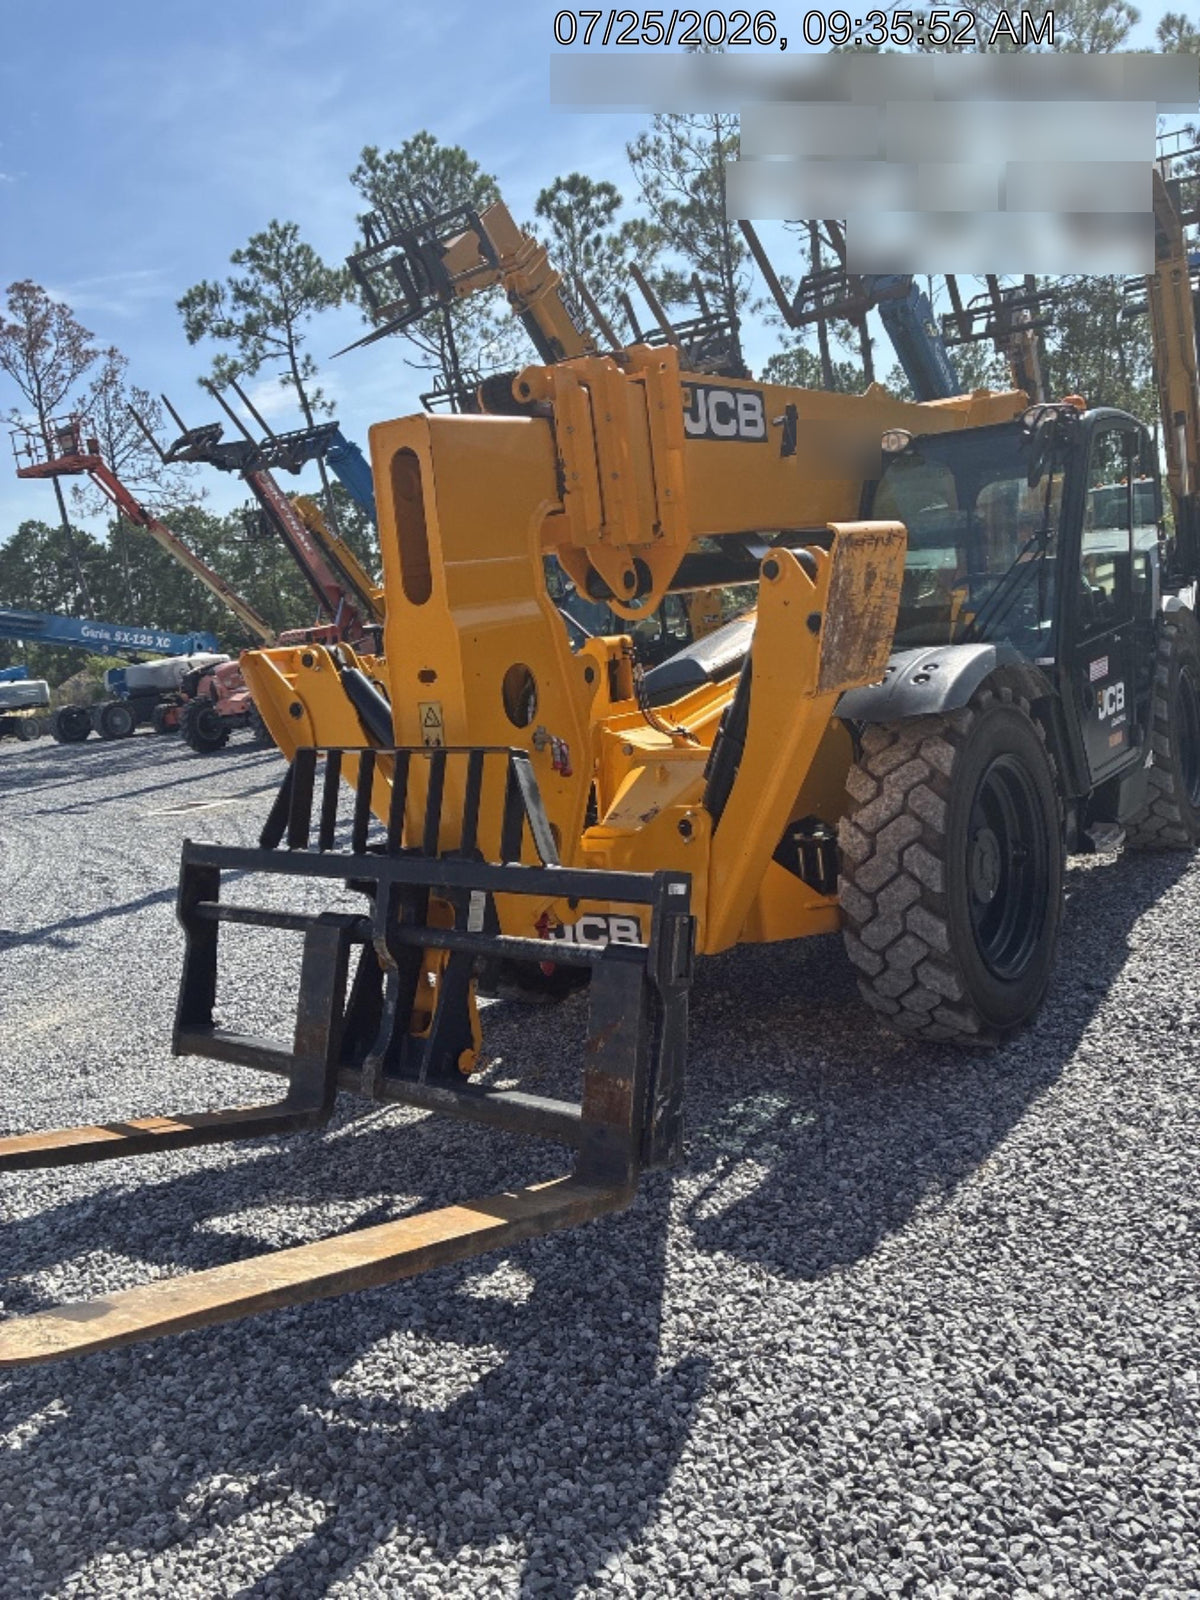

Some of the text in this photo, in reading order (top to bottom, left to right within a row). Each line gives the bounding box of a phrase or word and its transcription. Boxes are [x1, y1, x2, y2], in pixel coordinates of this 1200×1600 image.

[684, 388, 766, 438] JCB
[81, 625, 171, 648] Genie SX-125 XC
[1098, 682, 1125, 720] JCB
[548, 916, 641, 945] JCB
